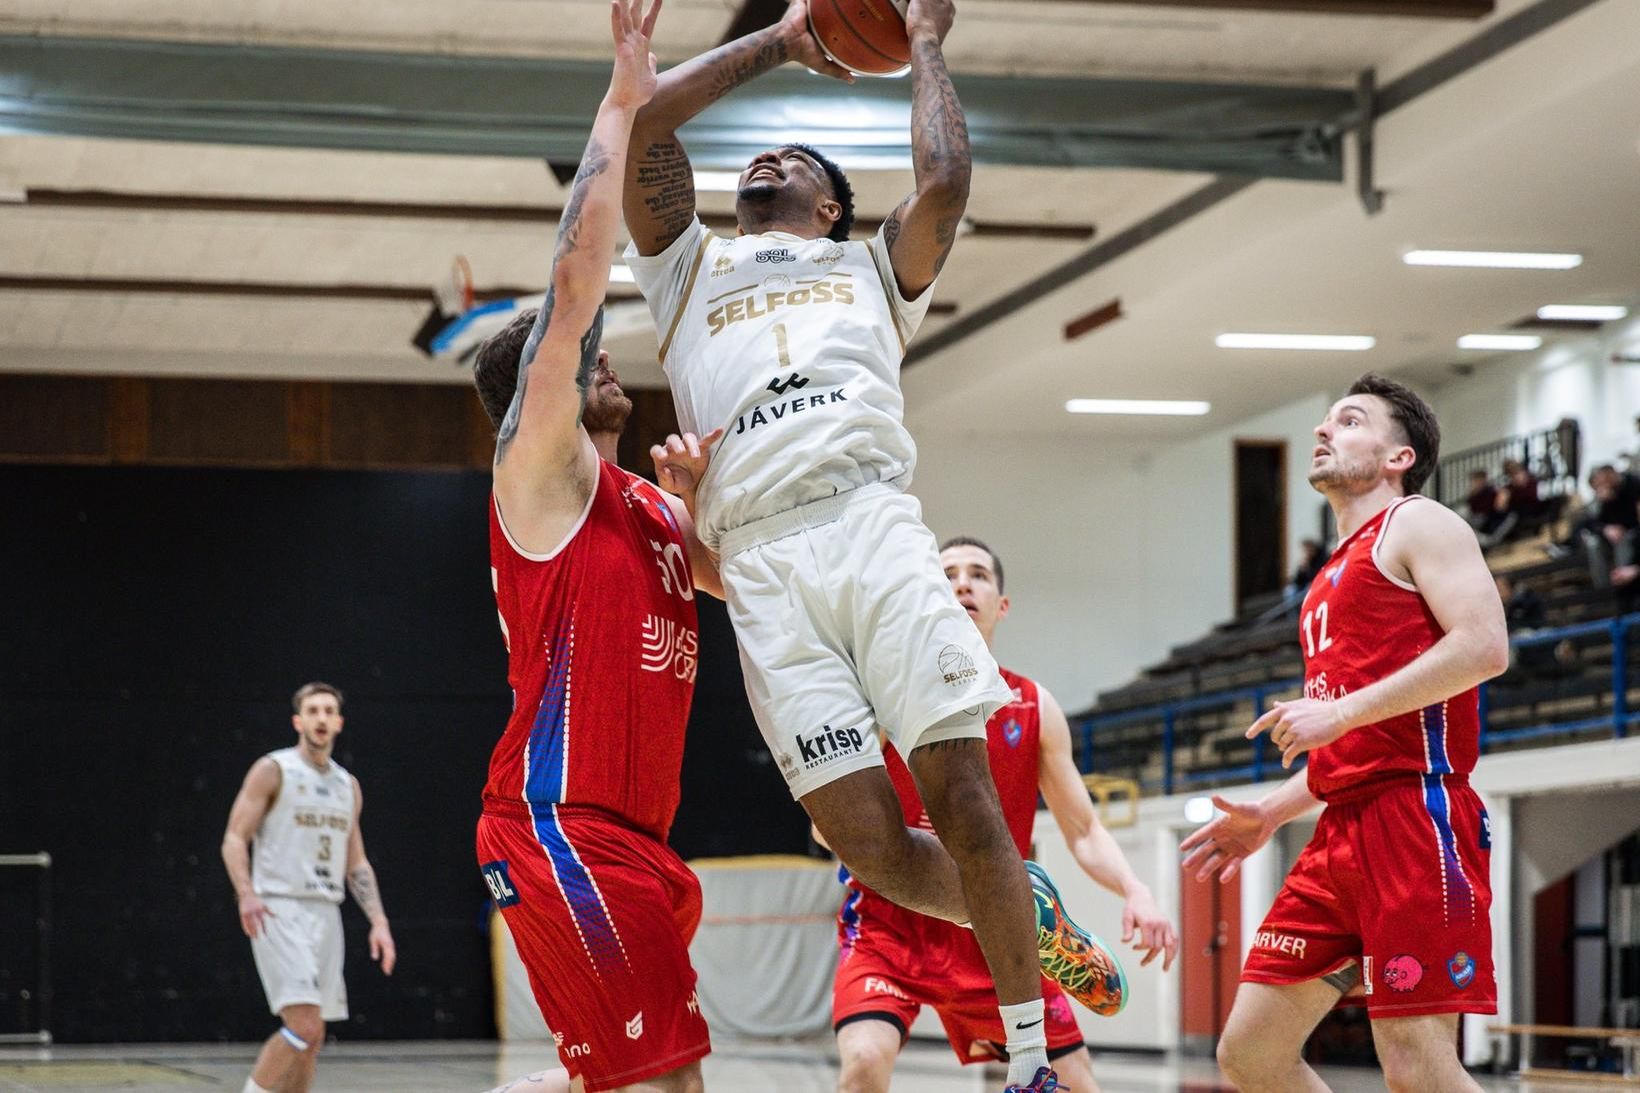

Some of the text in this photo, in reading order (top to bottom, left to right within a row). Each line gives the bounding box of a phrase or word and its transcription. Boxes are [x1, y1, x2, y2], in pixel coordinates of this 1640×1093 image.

[706, 281, 855, 338] SELFOSS
[771, 322, 791, 368] 1
[736, 387, 849, 435] JÁVERK
[1302, 600, 1333, 658] 12
[795, 724, 864, 763] krisp
[804, 748, 853, 771] RESTAURANT
